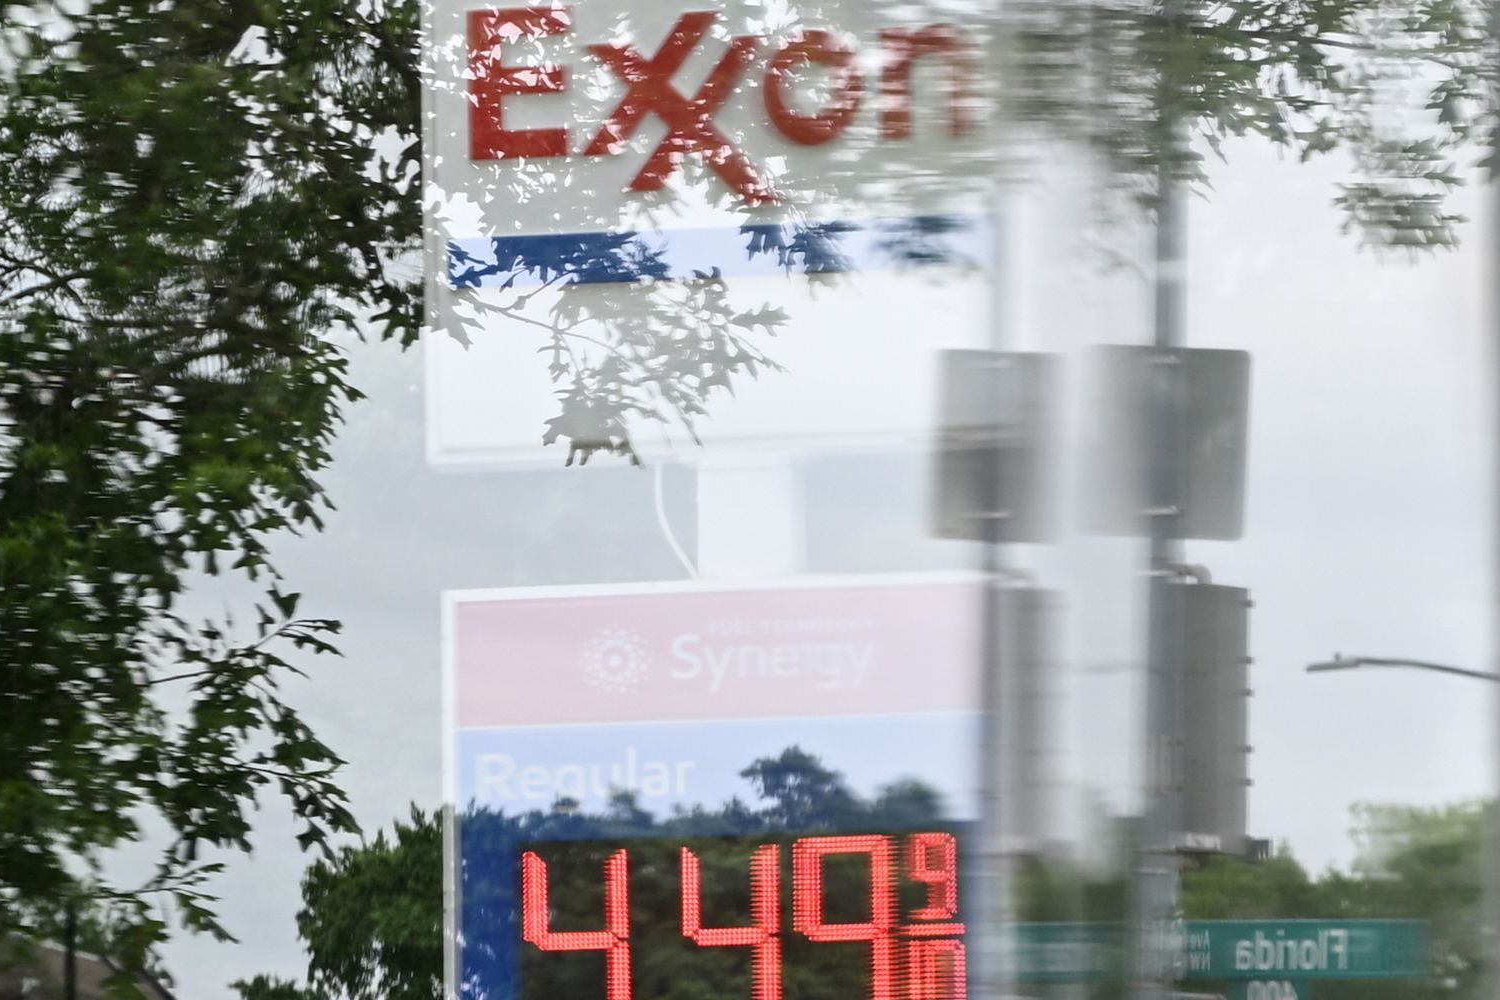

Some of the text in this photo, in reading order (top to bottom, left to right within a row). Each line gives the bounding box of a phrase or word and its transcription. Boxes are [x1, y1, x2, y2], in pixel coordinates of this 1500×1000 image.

[466, 7, 982, 203] Exxon
[670, 632, 878, 693] Synergy
[474, 744, 696, 812] Regular
